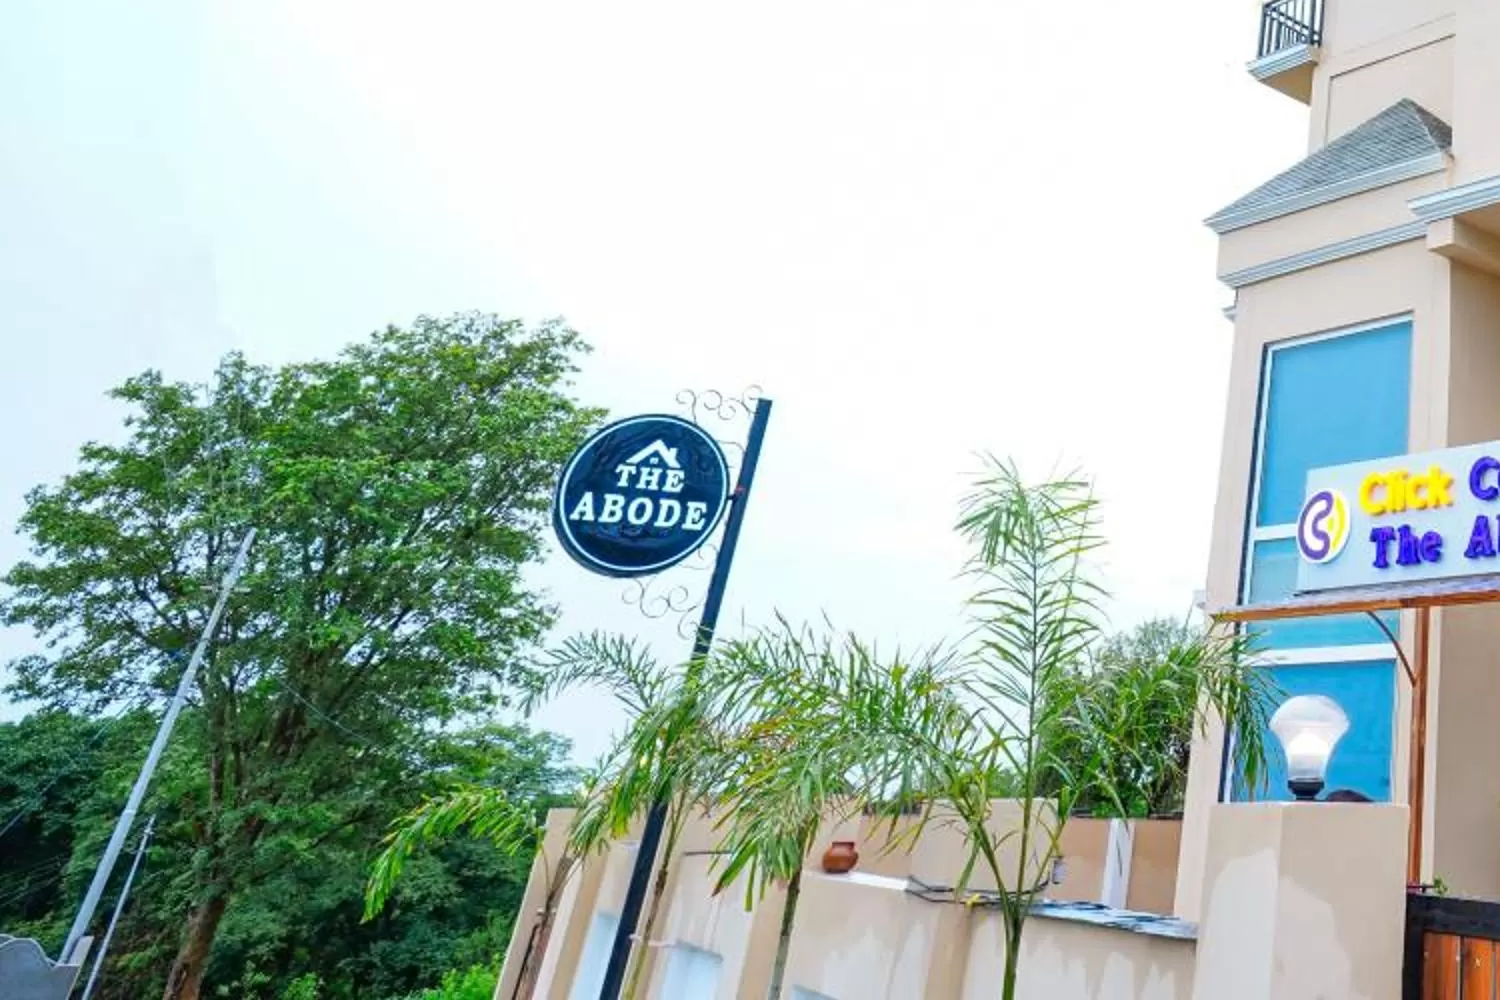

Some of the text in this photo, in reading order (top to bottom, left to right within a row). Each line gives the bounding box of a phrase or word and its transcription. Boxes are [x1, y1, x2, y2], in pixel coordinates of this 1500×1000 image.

[615, 463, 685, 493] THE
[1359, 465, 1454, 516] Click
[569, 491, 707, 531] ABODE
[1369, 525, 1444, 569] The
